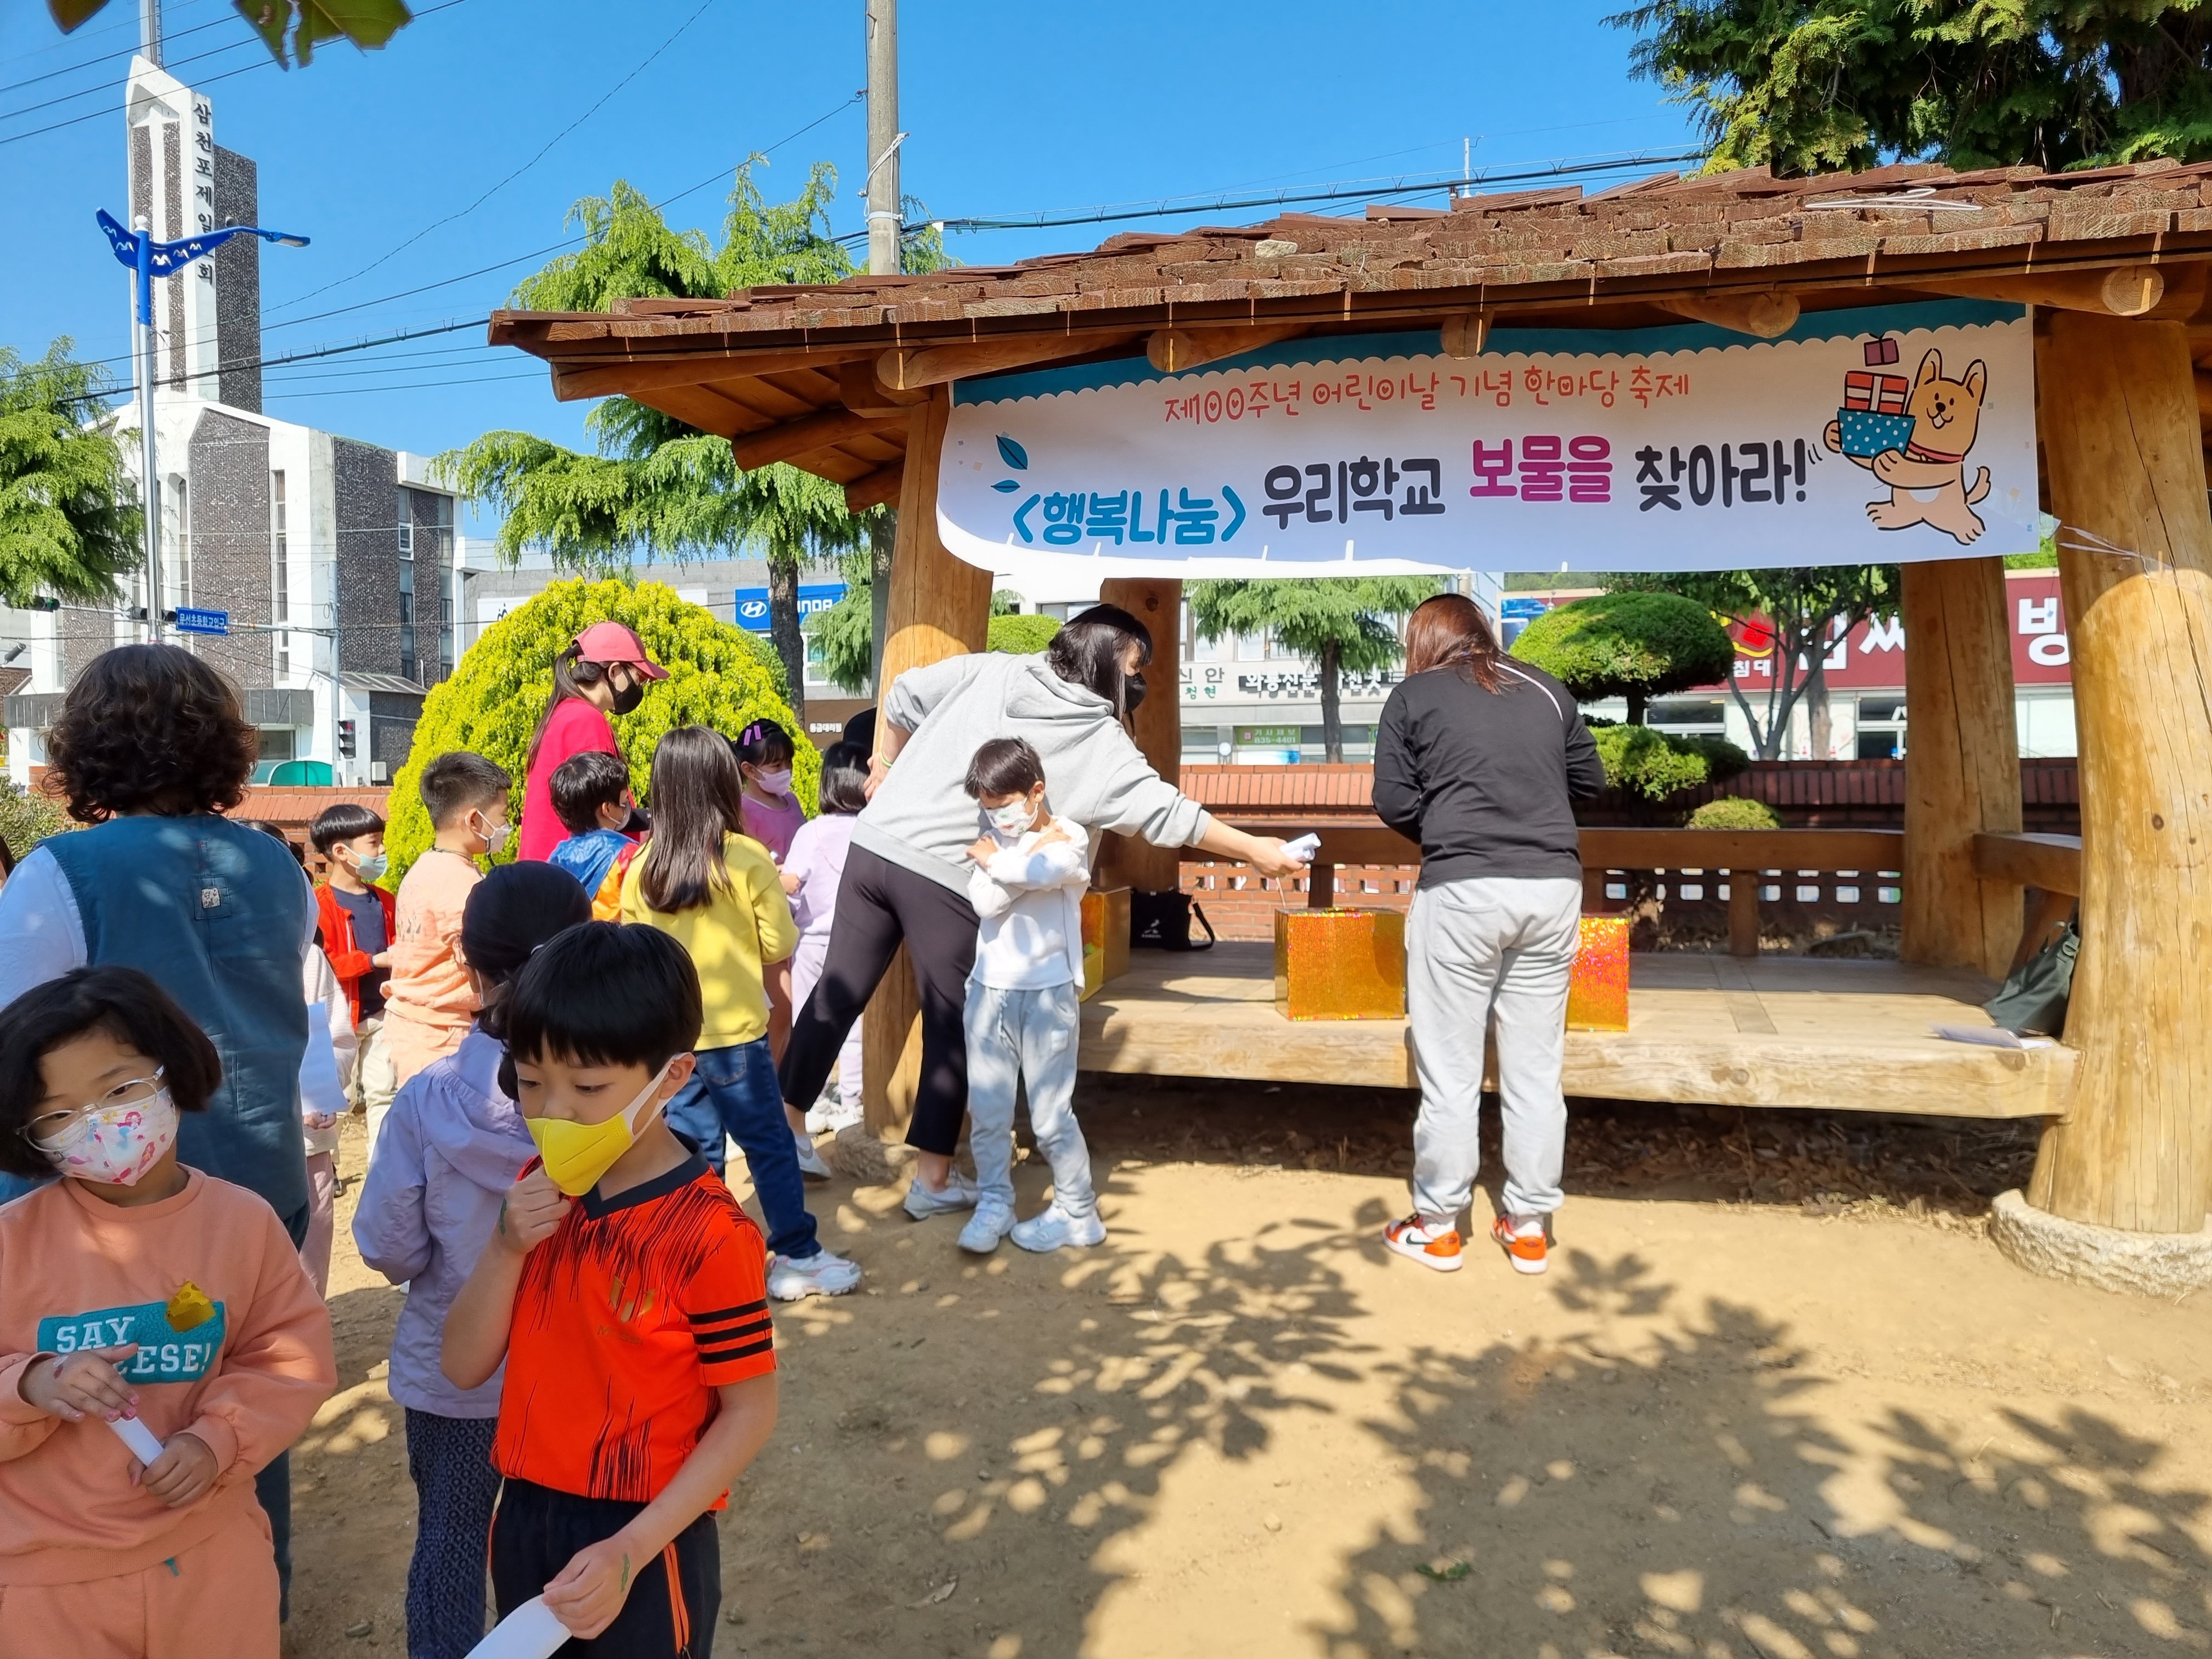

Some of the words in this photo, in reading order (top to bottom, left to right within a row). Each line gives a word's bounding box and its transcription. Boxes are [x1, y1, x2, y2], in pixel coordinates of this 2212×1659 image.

[193, 102, 213, 286] 삼천포제일회
[1165, 381, 1301, 425] 제100주년
[1312, 372, 1440, 411] 어린이날
[1450, 370, 1511, 408] 기념
[1523, 365, 1620, 408] 한마당
[1629, 365, 1689, 409] 축제
[1262, 455, 1446, 530] 우리학교
[1470, 435, 1613, 503] 보물을
[1635, 438, 1806, 512] 찾아라!
[56, 1317, 135, 1353] SAY
